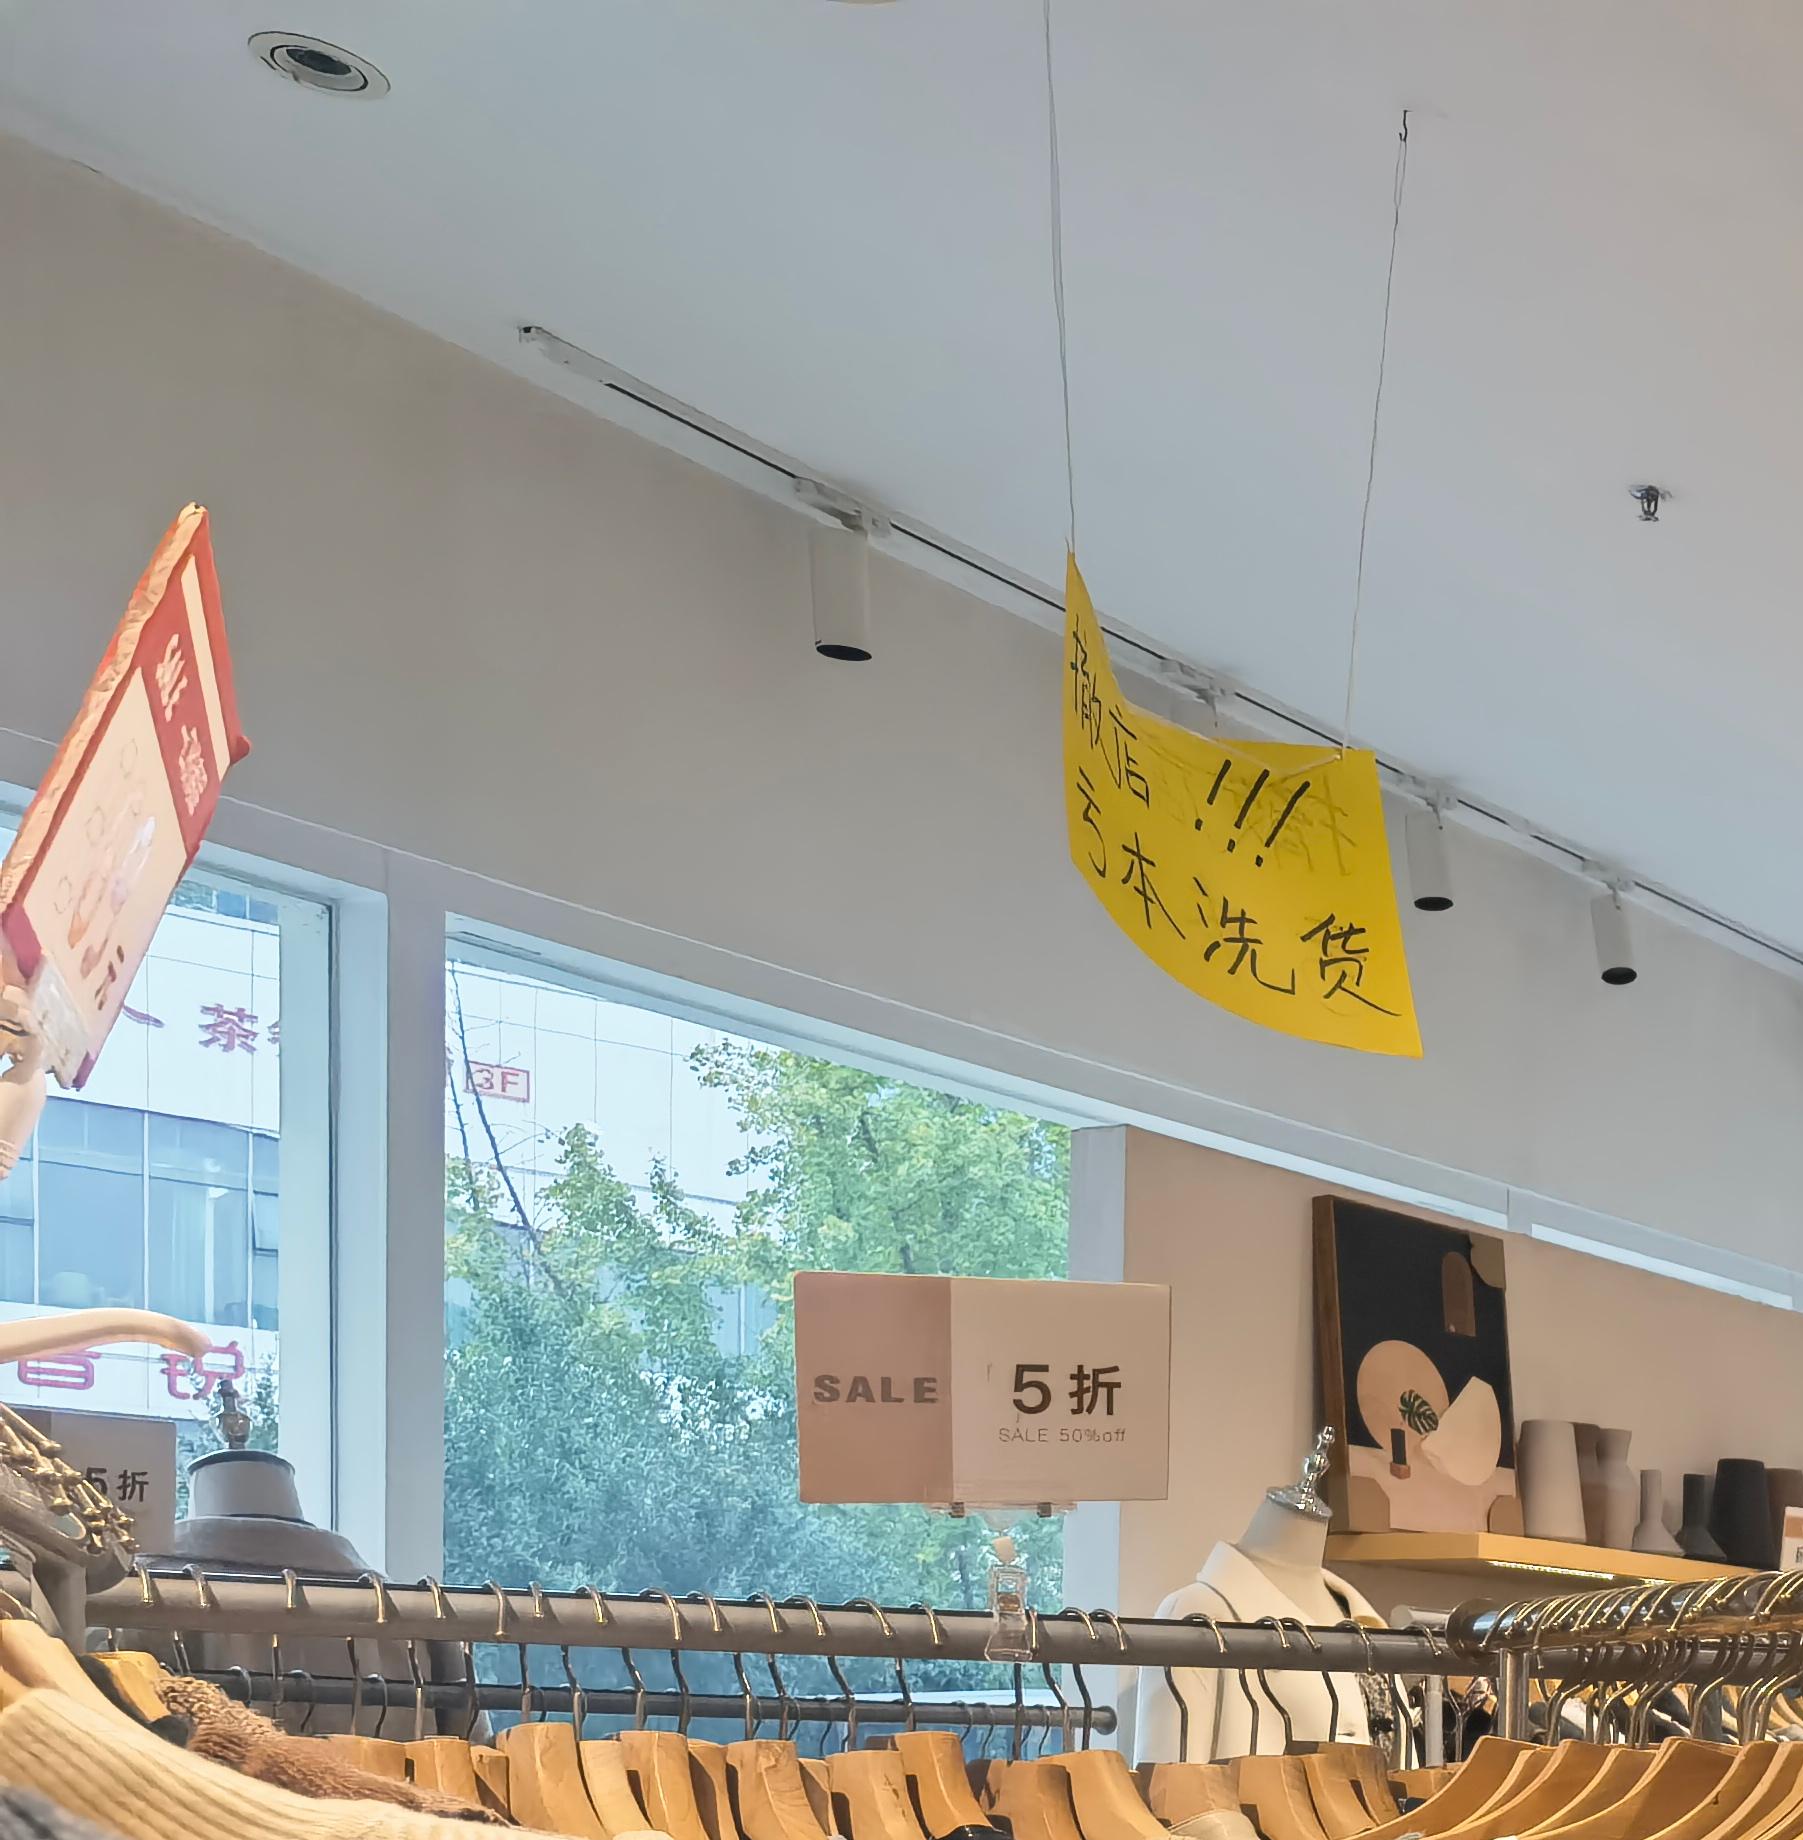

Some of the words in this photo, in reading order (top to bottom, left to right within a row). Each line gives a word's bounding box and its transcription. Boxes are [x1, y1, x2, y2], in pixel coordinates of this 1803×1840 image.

[1077, 767, 1402, 1017] 亏本洗货
[812, 1373, 939, 1404] SALE
[1012, 1364, 1122, 1417] 5折
[998, 1427, 1049, 1444] SALE
